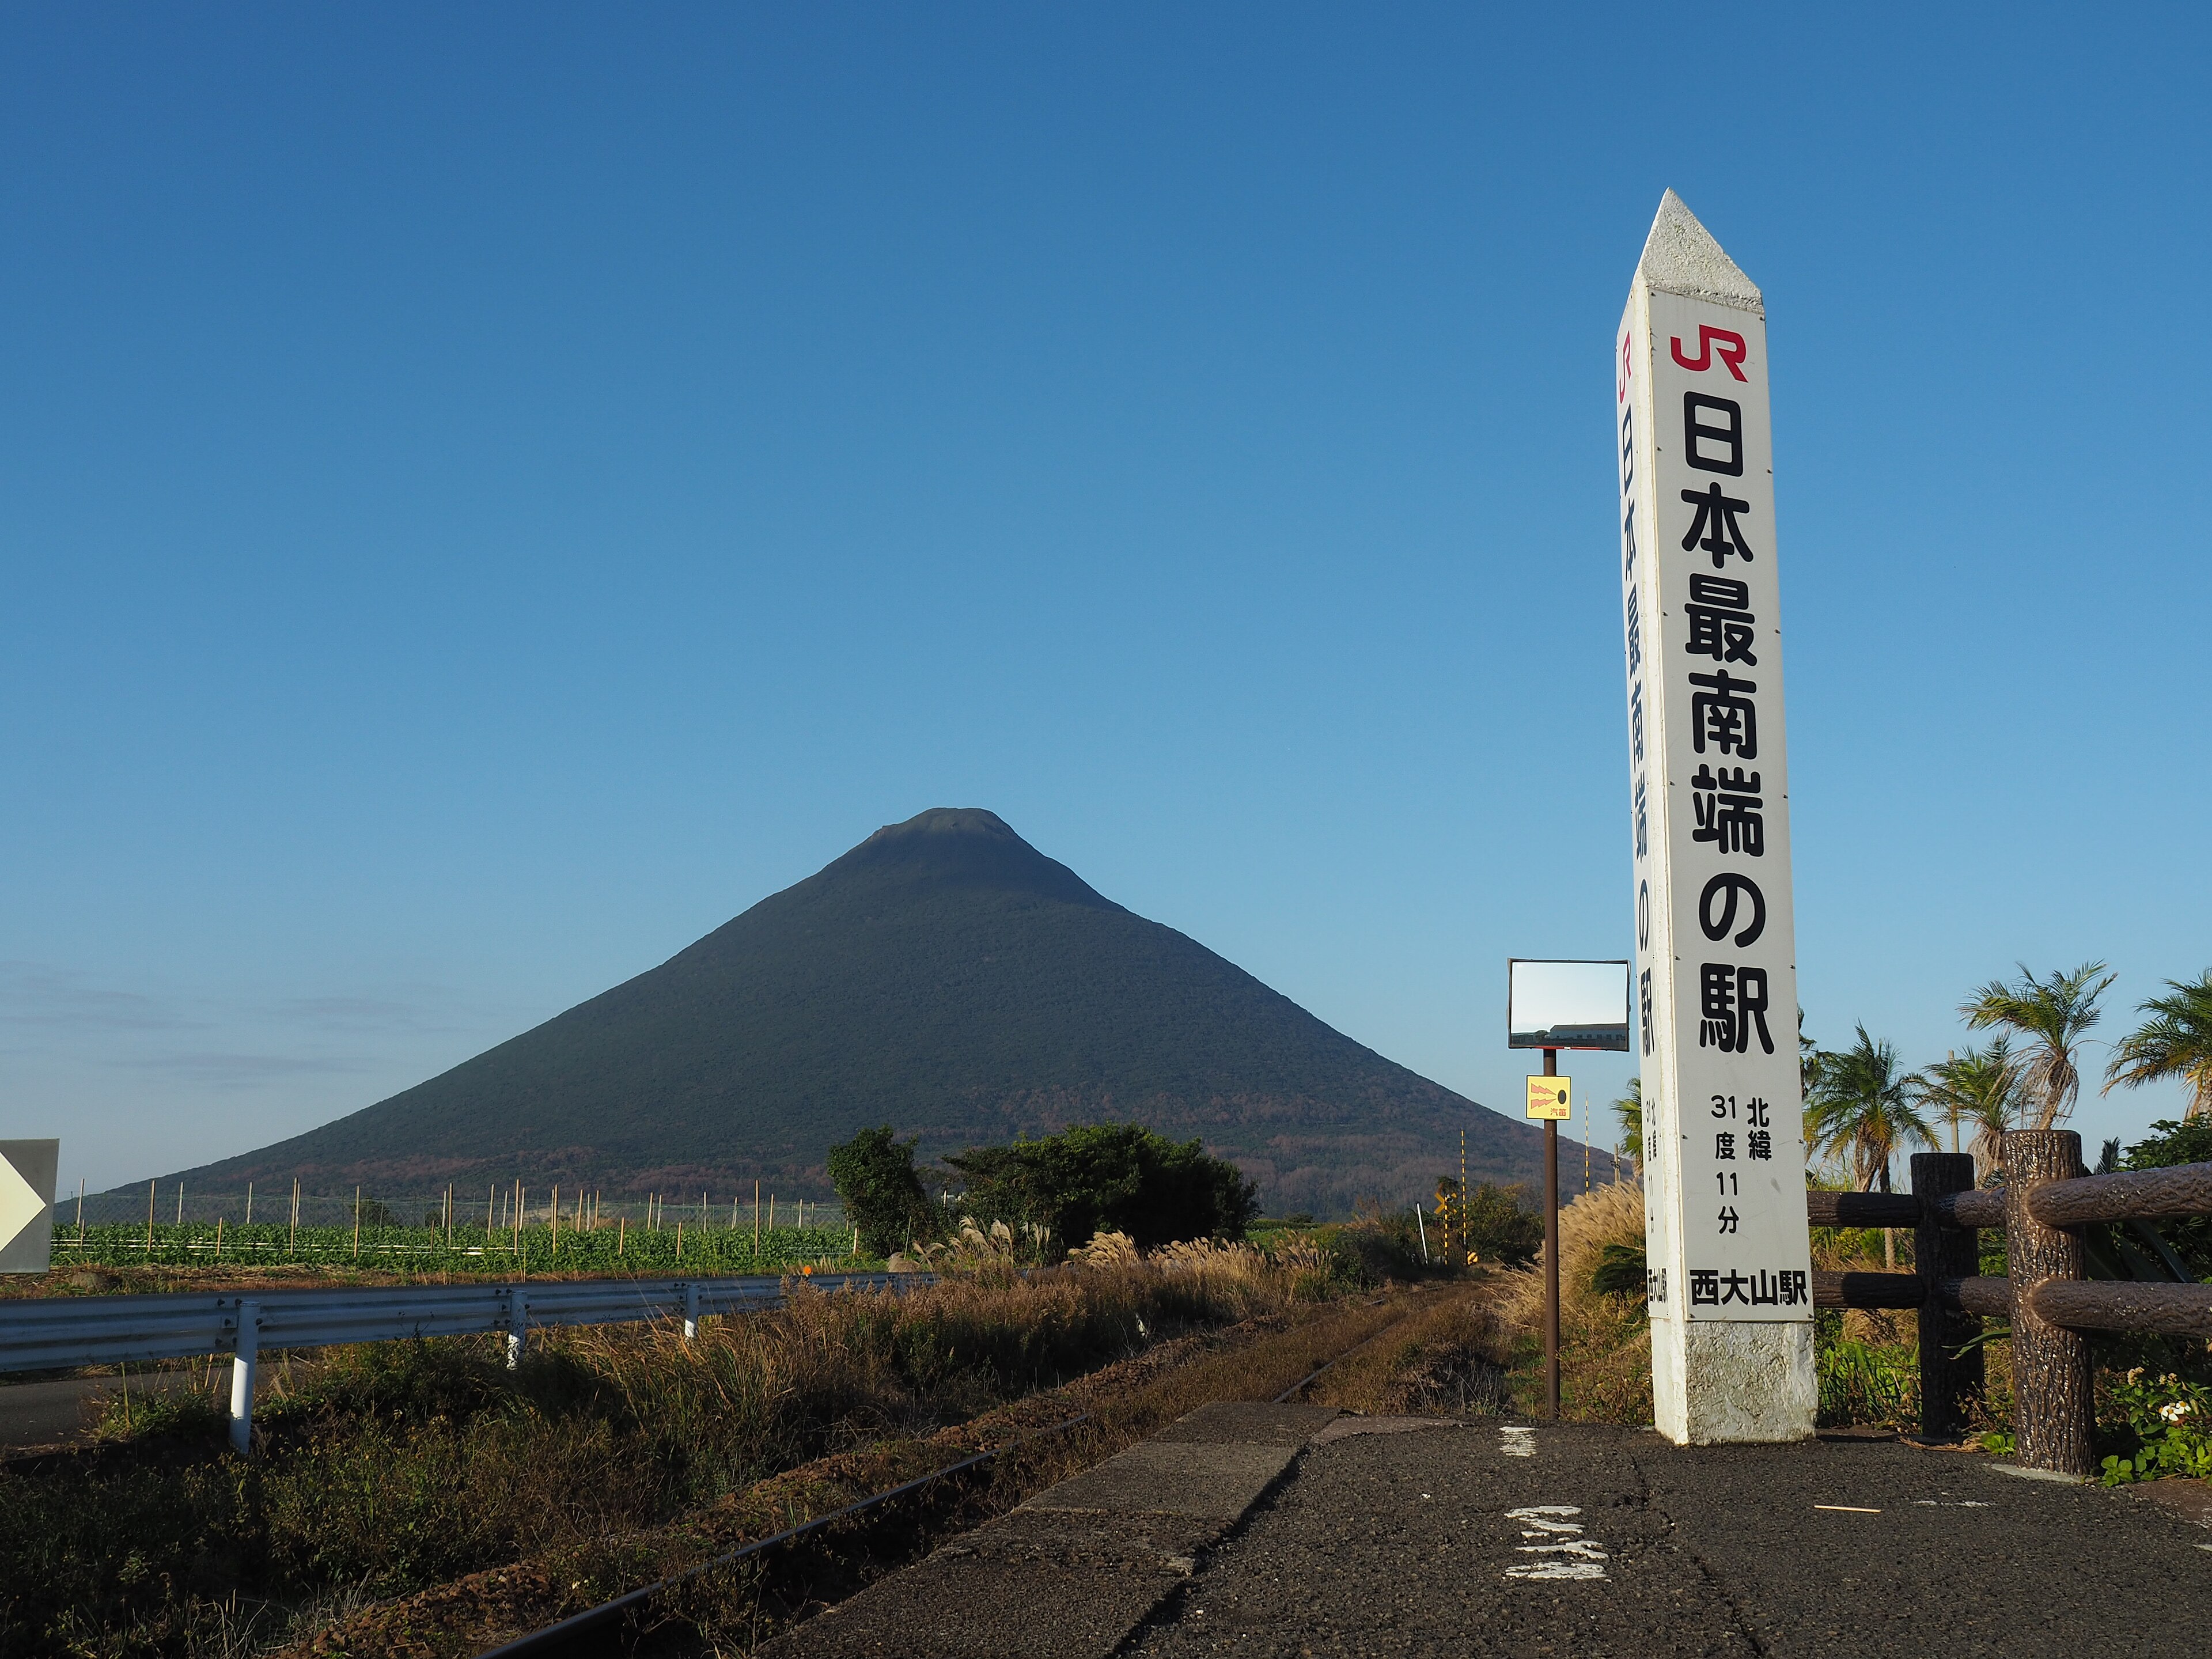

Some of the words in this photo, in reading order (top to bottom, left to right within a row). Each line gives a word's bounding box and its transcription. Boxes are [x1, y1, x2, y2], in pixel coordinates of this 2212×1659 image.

[1619, 330, 1631, 404] JR
[1671, 324, 1748, 383] JR
[1680, 391, 1775, 1055] 日本最南端の駅
[1747, 1097, 1772, 1162] 北緯
[1689, 1269, 1808, 1306] 西大山駅
